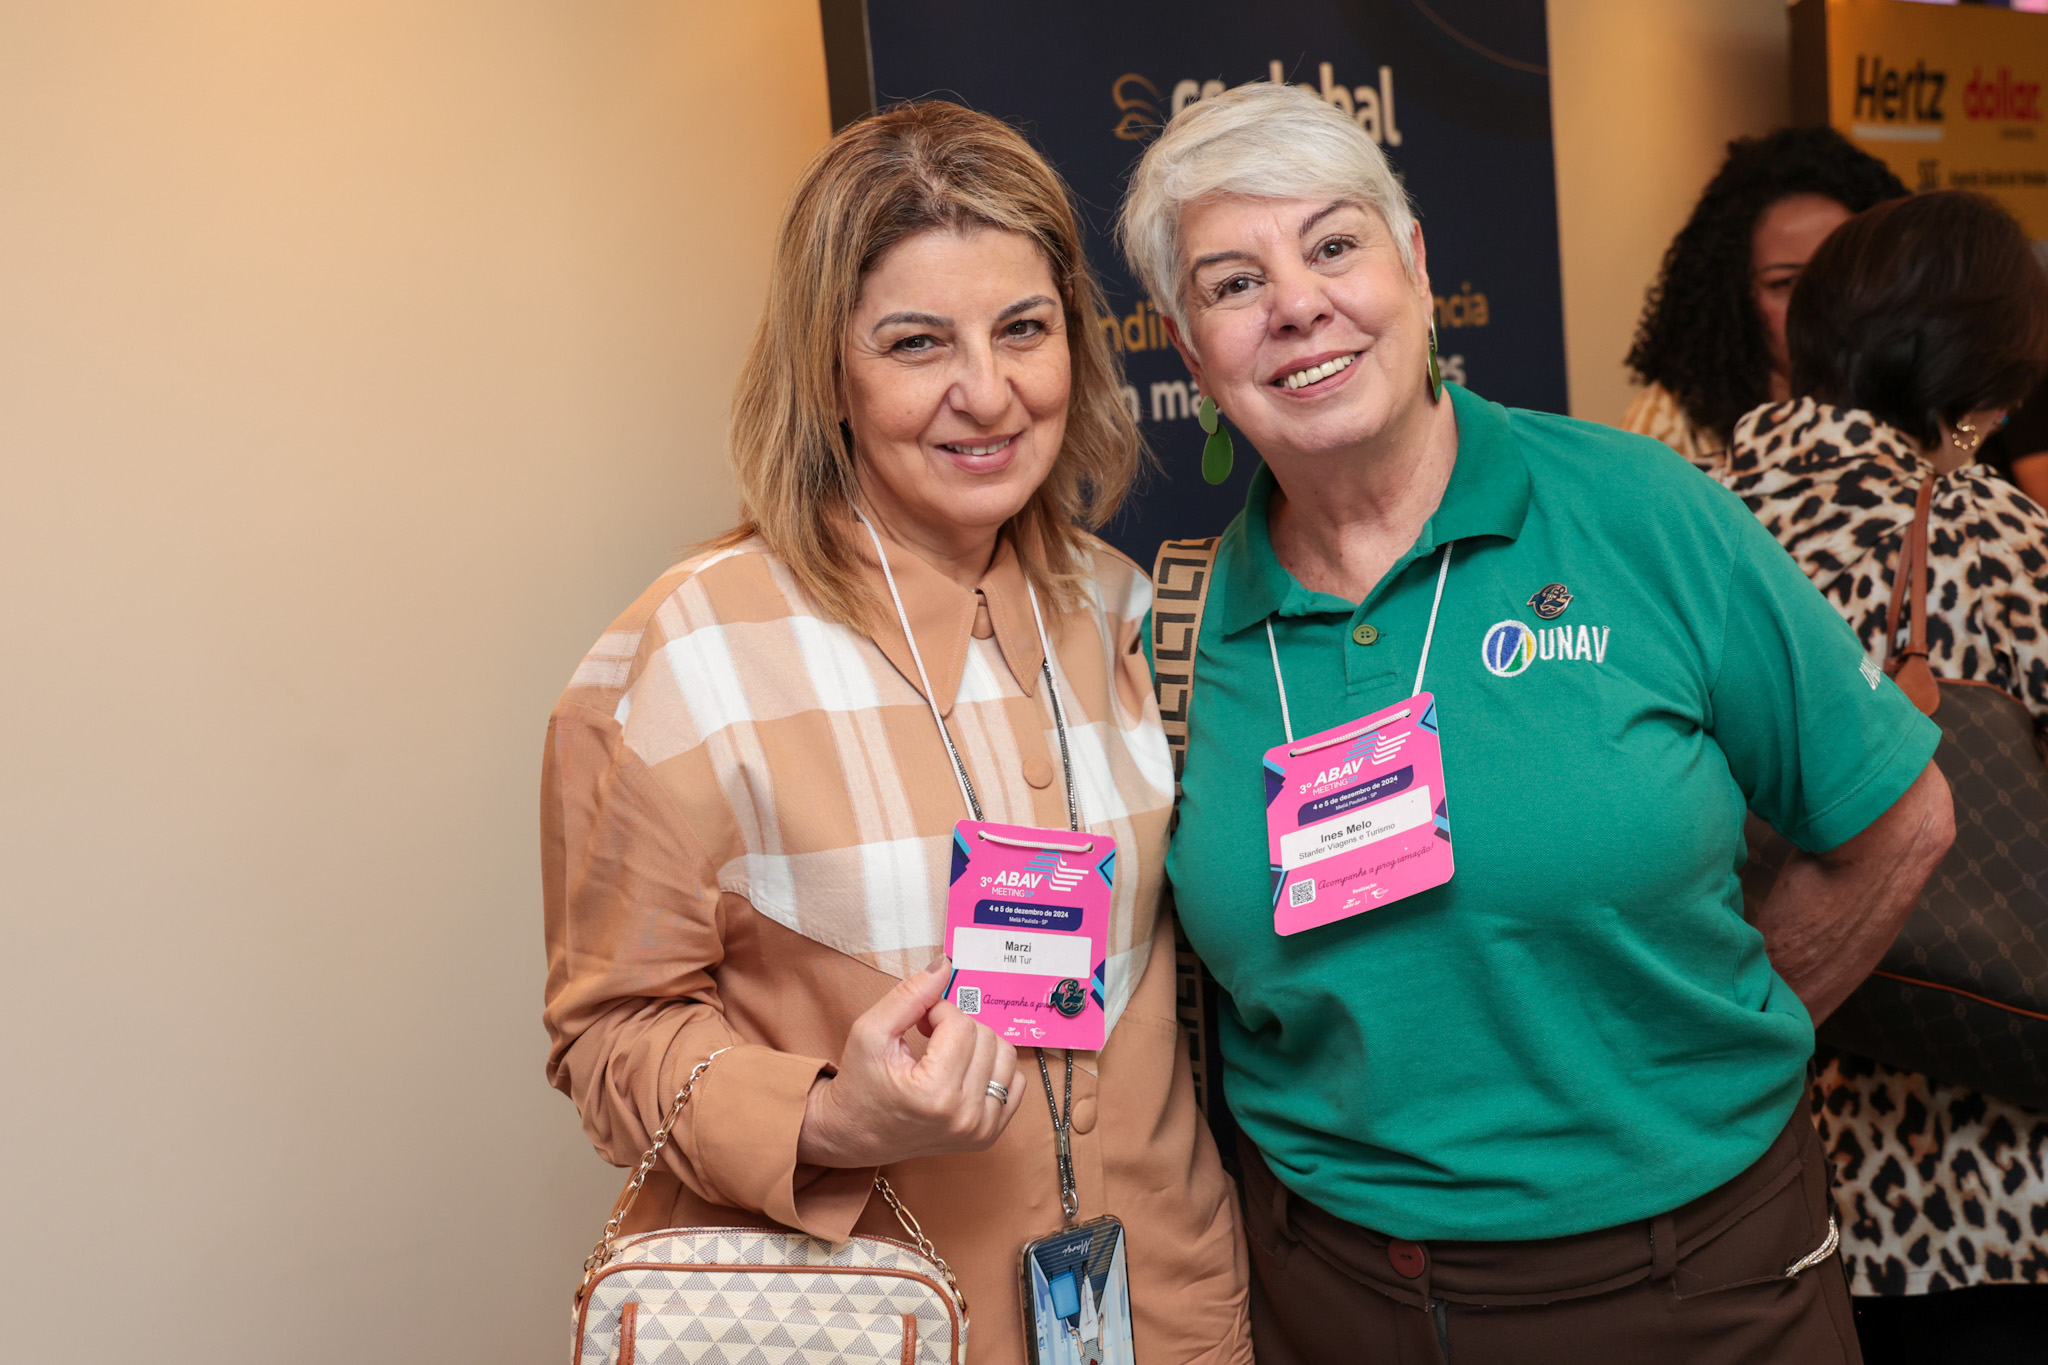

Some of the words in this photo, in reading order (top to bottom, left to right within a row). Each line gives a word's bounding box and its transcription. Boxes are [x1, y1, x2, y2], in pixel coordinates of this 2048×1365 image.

[1854, 54, 1946, 121] Hertz
[1538, 624, 1611, 664] UNAV
[1314, 757, 1364, 787] ABAV
[1330, 797, 1339, 805] de
[1339, 786, 1371, 802] dezembro
[1372, 782, 1381, 790] de
[1381, 775, 1399, 787] 2024
[1298, 846, 1326, 860] Stanfer
[1327, 836, 1357, 851] Viagens
[1365, 822, 1396, 838] Turismo
[1320, 830, 1343, 843] Ines
[1346, 820, 1372, 835] Melo
[1317, 867, 1367, 890] Acompanhe
[1375, 842, 1435, 875] programação!
[993, 870, 1044, 889] ABAV
[1005, 906, 1013, 914] de
[1014, 906, 1043, 916] dezembro
[1044, 908, 1052, 917] de
[1053, 910, 1069, 918] 2024
[1003, 954, 1017, 964] HM
[1019, 955, 1032, 965] Tur
[1005, 940, 1032, 953] Marzi
[983, 994, 1028, 1010] Acompanhe
